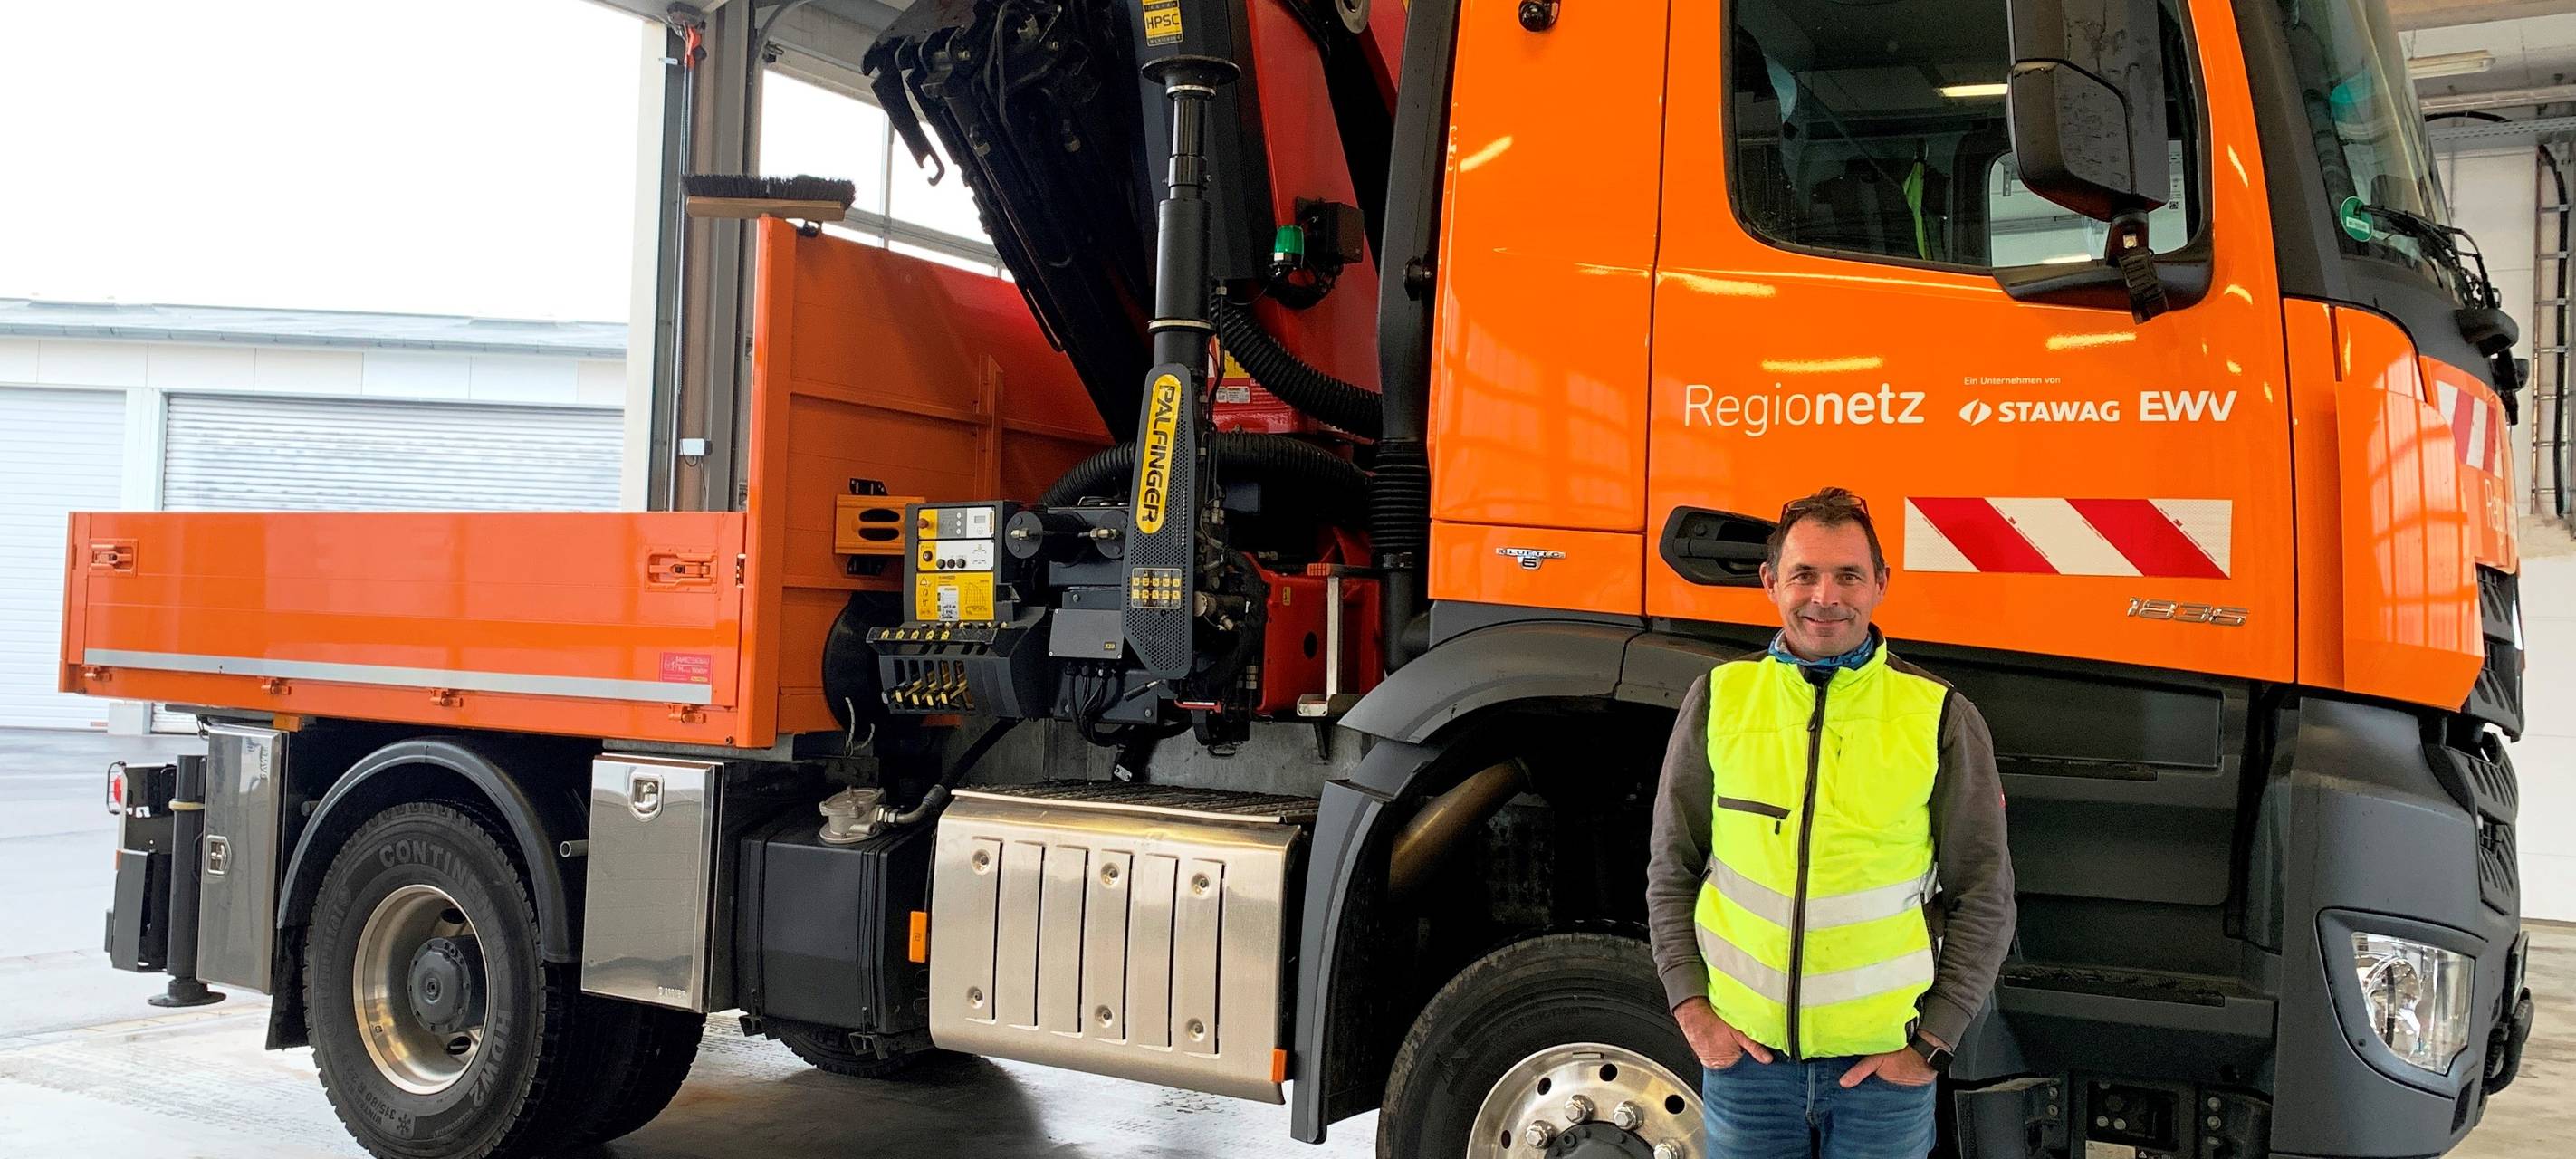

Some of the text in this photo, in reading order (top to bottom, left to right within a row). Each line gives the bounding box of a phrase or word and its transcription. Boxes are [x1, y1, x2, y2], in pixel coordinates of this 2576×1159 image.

[1146, 14, 1180, 30] HPSC
[1964, 376, 2061, 385] Ein Unternehmen von
[1684, 382, 1926, 437] Regionetz
[1998, 401, 2121, 423] STAWAG
[2140, 390, 2238, 422] EWV
[1142, 385, 1175, 522] PALFINGER
[468, 1009, 512, 1107] HDW2
